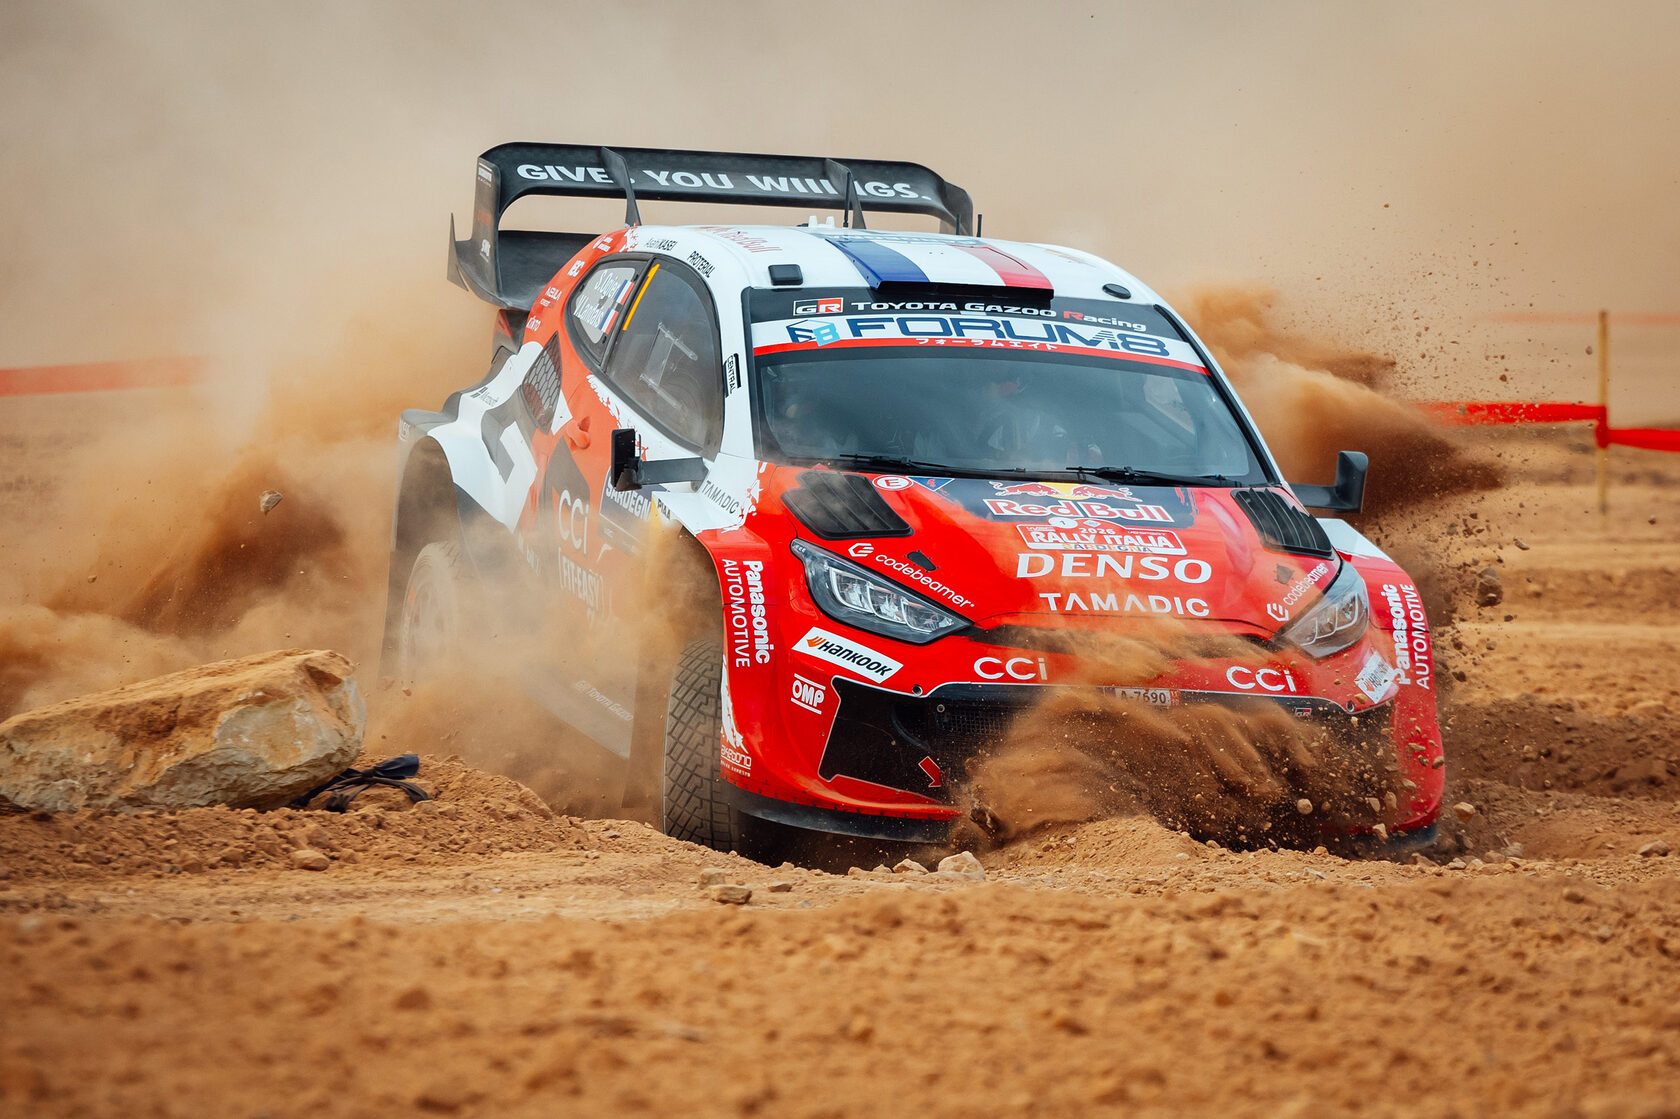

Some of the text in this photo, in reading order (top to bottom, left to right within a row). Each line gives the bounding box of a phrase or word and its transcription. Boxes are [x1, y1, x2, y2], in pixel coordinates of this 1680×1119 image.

[642, 170, 734, 189] YOU
[687, 251, 716, 278] PROTERIAL
[796, 302, 1147, 332] GR TOYOTA GAZOO Racing
[845, 316, 1170, 357] FORUM8
[915, 338, 1058, 350] フォーラムエイト
[727, 356, 736, 394] CENTRAL
[702, 480, 739, 514] TAMADIC
[983, 499, 1175, 523] Red Bull
[558, 489, 589, 555] CCi
[1030, 531, 1175, 548] RALLY ITALIA
[1063, 543, 1152, 553] SARDEGNA
[1016, 553, 1212, 584] DENSO
[1283, 562, 1329, 606] codebeamer
[722, 558, 750, 668] AUTOMOTIVE
[743, 560, 774, 664] Panasonic
[1039, 593, 1210, 617] TAMADIC
[1381, 584, 1411, 685] Panasonic
[1400, 583, 1430, 690] AUTOMOTIVE
[973, 656, 1048, 681] CCi
[1226, 665, 1297, 692] CCi
[792, 679, 825, 708] OMP
